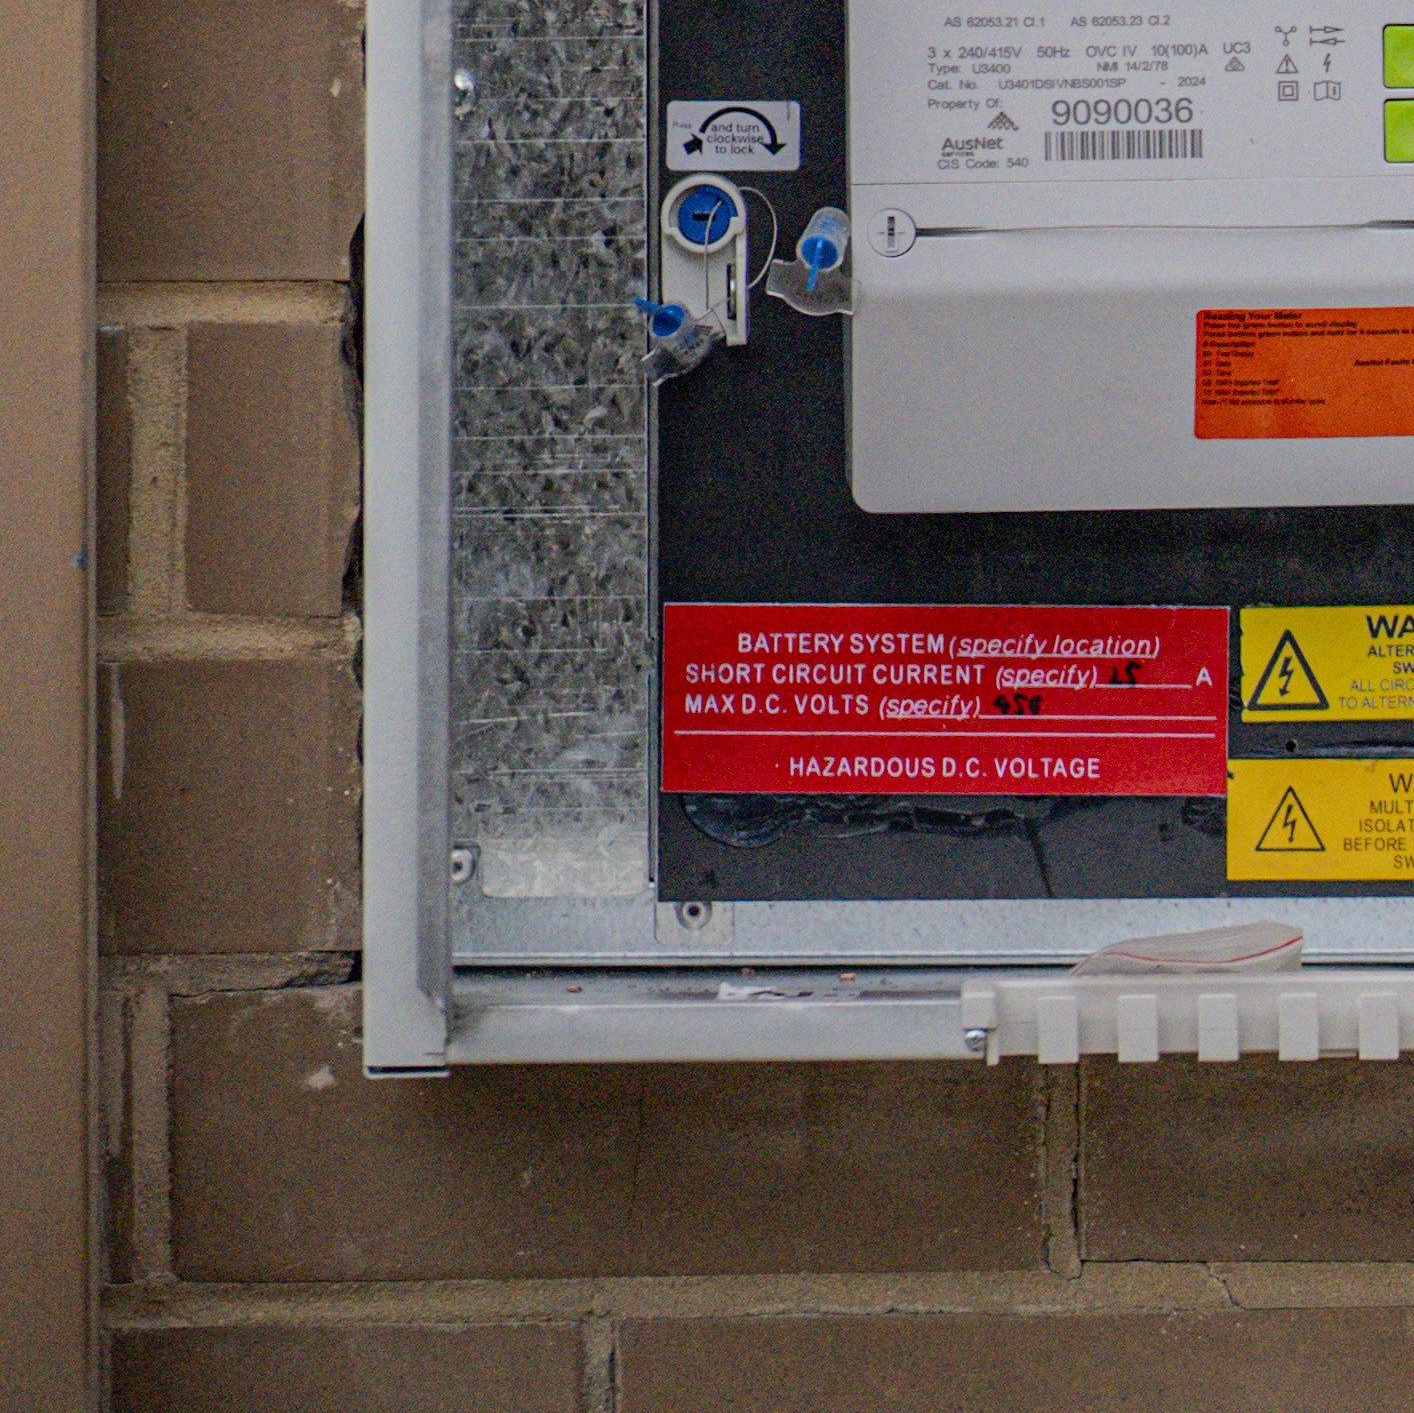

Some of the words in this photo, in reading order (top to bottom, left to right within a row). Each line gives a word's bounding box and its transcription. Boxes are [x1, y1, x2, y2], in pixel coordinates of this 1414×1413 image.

[944, 17, 961, 27] AS
[967, 16, 1018, 27] 62053.21
[958, 45, 1022, 58] 240/415V
[1036, 45, 1069, 57] 50Hz
[1086, 45, 1116, 57] OVC
[1151, 42, 1208, 57] 10(100)A
[1223, 42, 1251, 54] UC3
[972, 63, 1011, 73] U3400
[1051, 98, 1193, 126] 9090036
[711, 123, 732, 133] and
[737, 124, 760, 133] turn
[707, 134, 763, 144] clockwise
[941, 137, 1003, 150] AusNet
[715, 145, 727, 155] to
[730, 144, 754, 155] lock
[1007, 157, 1028, 168] 540
[738, 634, 845, 655] BATTERY
[851, 635, 945, 655] SYSTEM
[949, 635, 1046, 659] (specify
[1052, 635, 1160, 659] location)
[685, 665, 763, 684] SHORT
[772, 665, 865, 685] CIRCUIT
[872, 665, 984, 685] CURRENT
[685, 695, 734, 714] MAX
[741, 695, 787, 714] D.C.
[794, 695, 868, 715] VOLTS
[789, 757, 935, 777] HAZARDOUS
[942, 758, 988, 777] D.C.
[994, 759, 1099, 778] VOLTAGE
[1344, 838, 1406, 851] BEFORE
